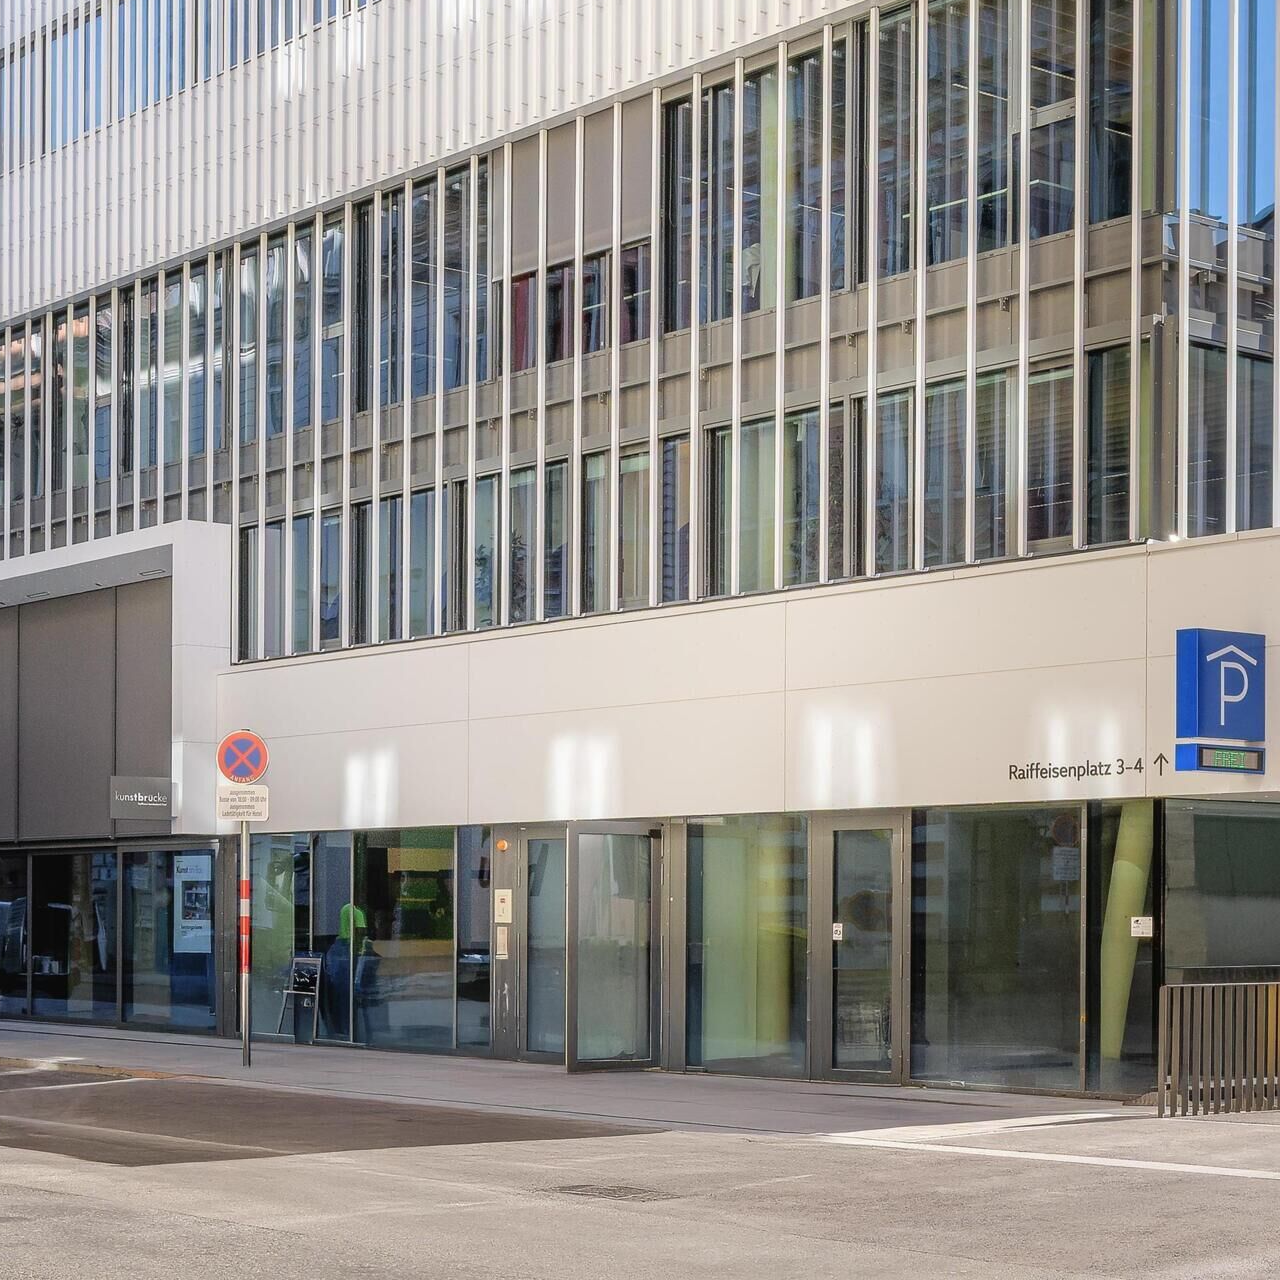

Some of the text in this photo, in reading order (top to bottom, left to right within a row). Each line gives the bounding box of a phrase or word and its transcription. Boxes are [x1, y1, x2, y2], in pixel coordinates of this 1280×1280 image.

[1221, 661, 1248, 725] P
[1009, 759, 1111, 781] Raiffeisenplatz
[1214, 751, 1246, 769] FREI
